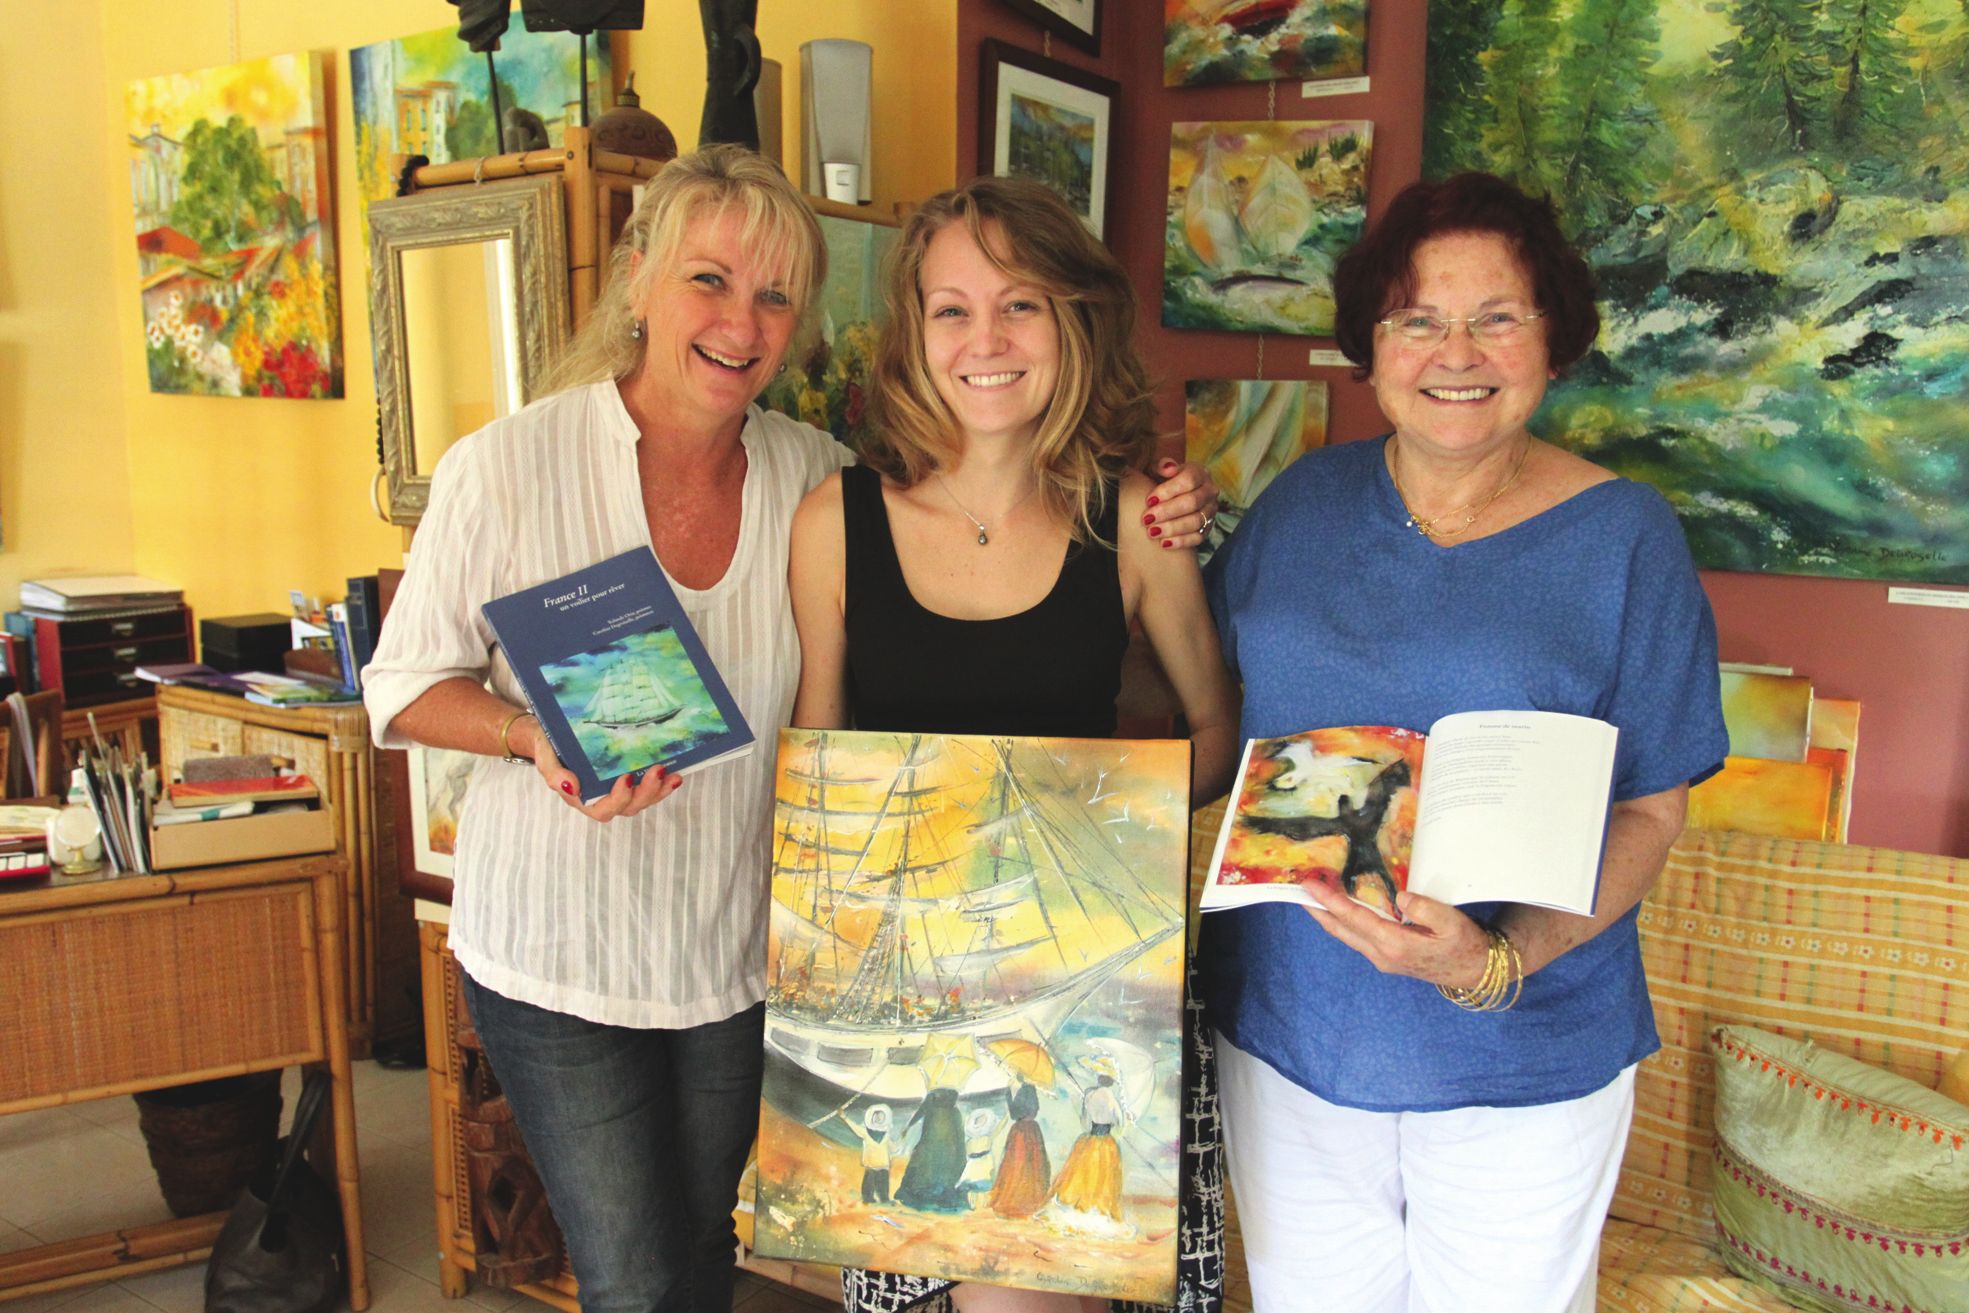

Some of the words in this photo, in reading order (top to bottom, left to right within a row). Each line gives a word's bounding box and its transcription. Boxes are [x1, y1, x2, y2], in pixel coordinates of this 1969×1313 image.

[543, 592, 576, 608] France
[578, 584, 588, 596] II
[560, 603, 569, 611] un
[570, 596, 591, 608] voilier
[591, 589, 608, 602] pour
